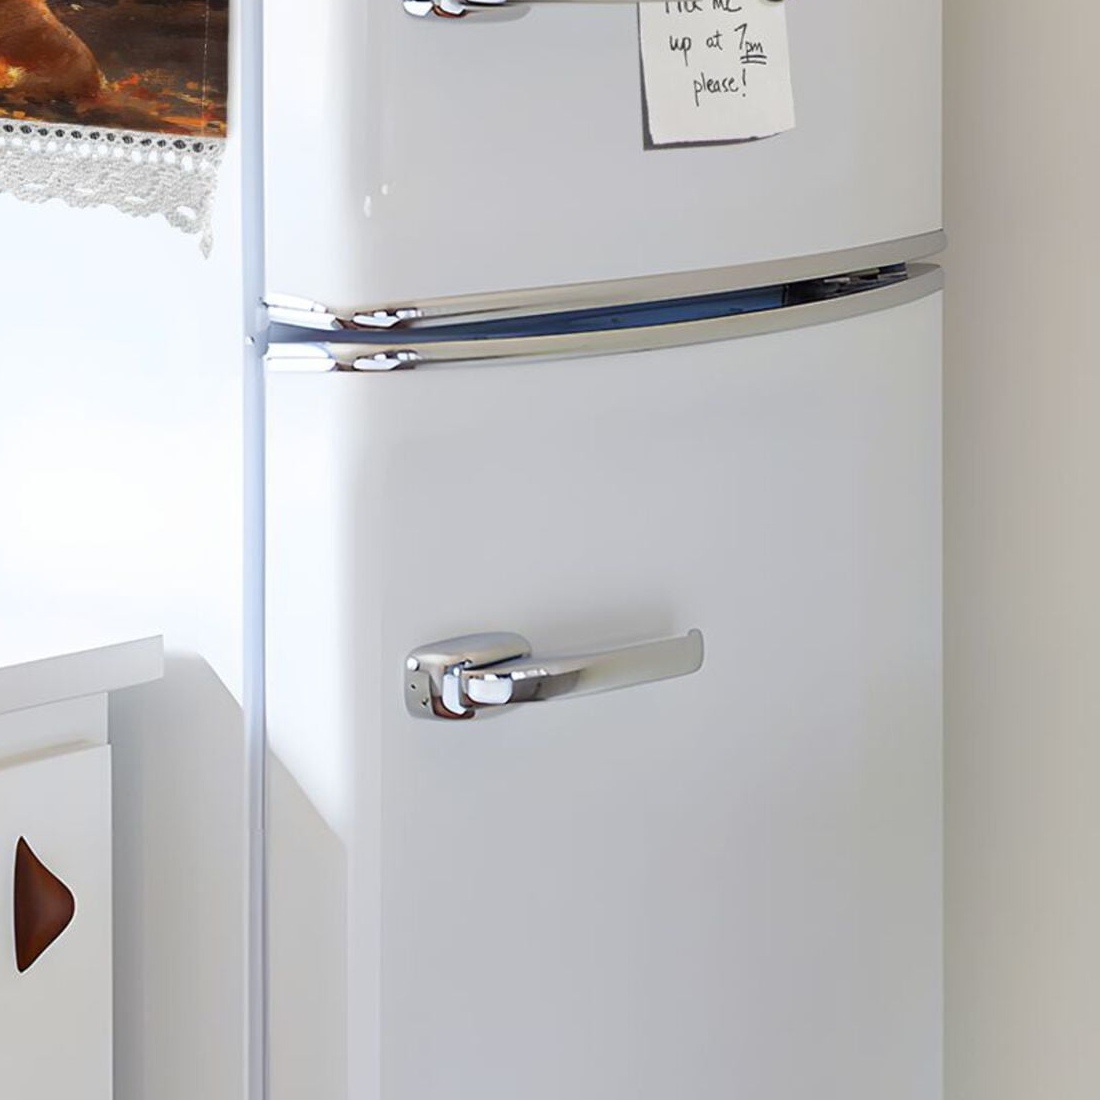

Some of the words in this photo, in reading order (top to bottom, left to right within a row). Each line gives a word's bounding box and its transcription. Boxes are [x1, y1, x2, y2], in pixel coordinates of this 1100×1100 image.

[669, 35, 692, 66] up
[706, 30, 723, 50] at
[693, 68, 746, 107] please!
